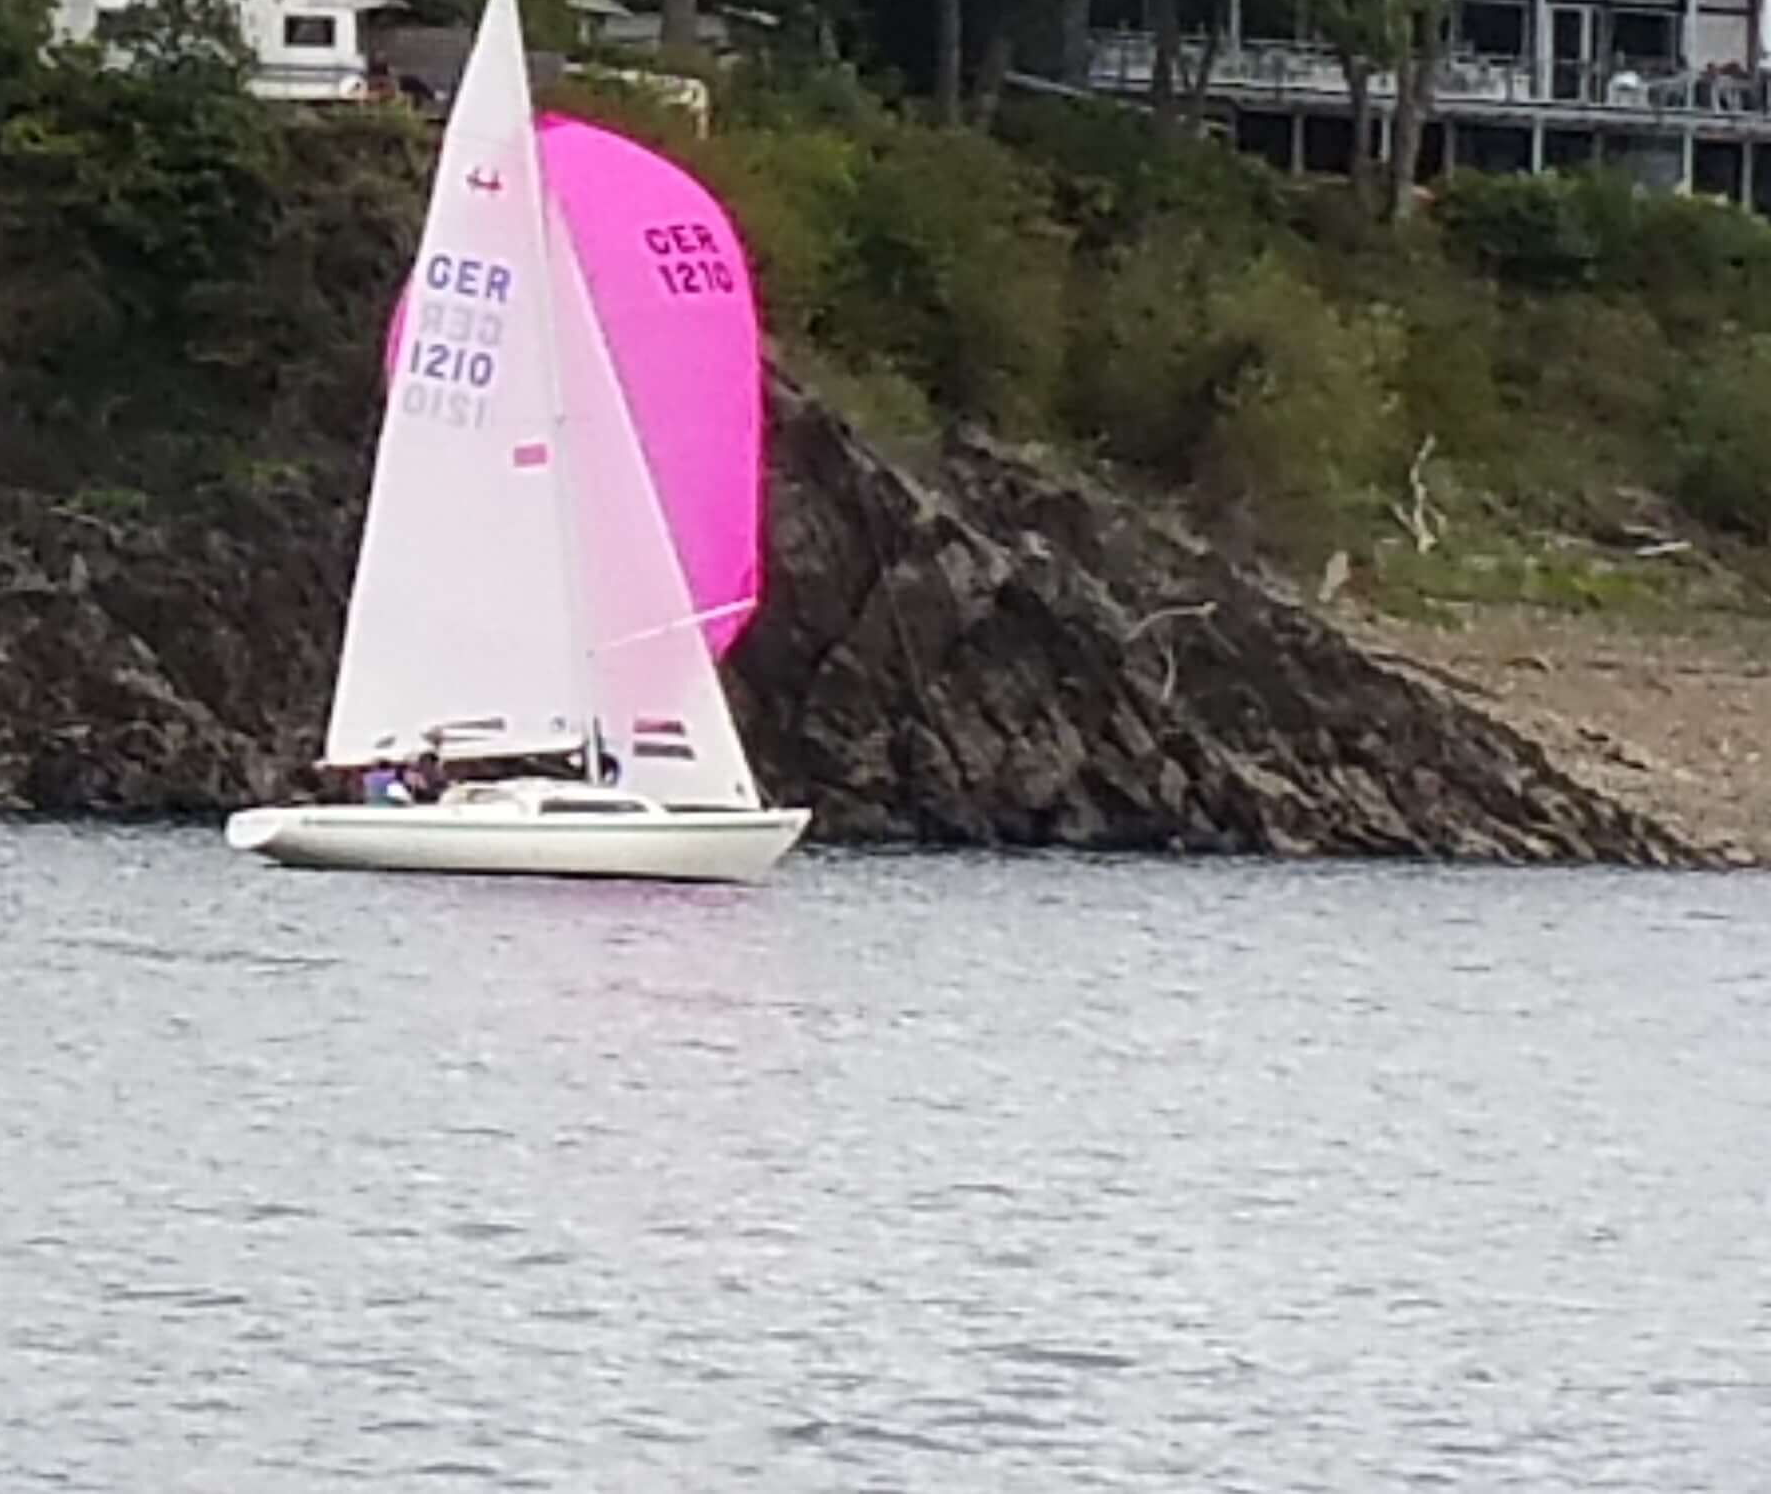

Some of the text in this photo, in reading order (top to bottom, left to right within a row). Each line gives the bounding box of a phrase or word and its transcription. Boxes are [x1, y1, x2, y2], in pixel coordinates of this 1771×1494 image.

[643, 223, 720, 254] GER
[426, 254, 512, 303] GER
[657, 260, 734, 294] 1210
[409, 340, 494, 388] 1210
